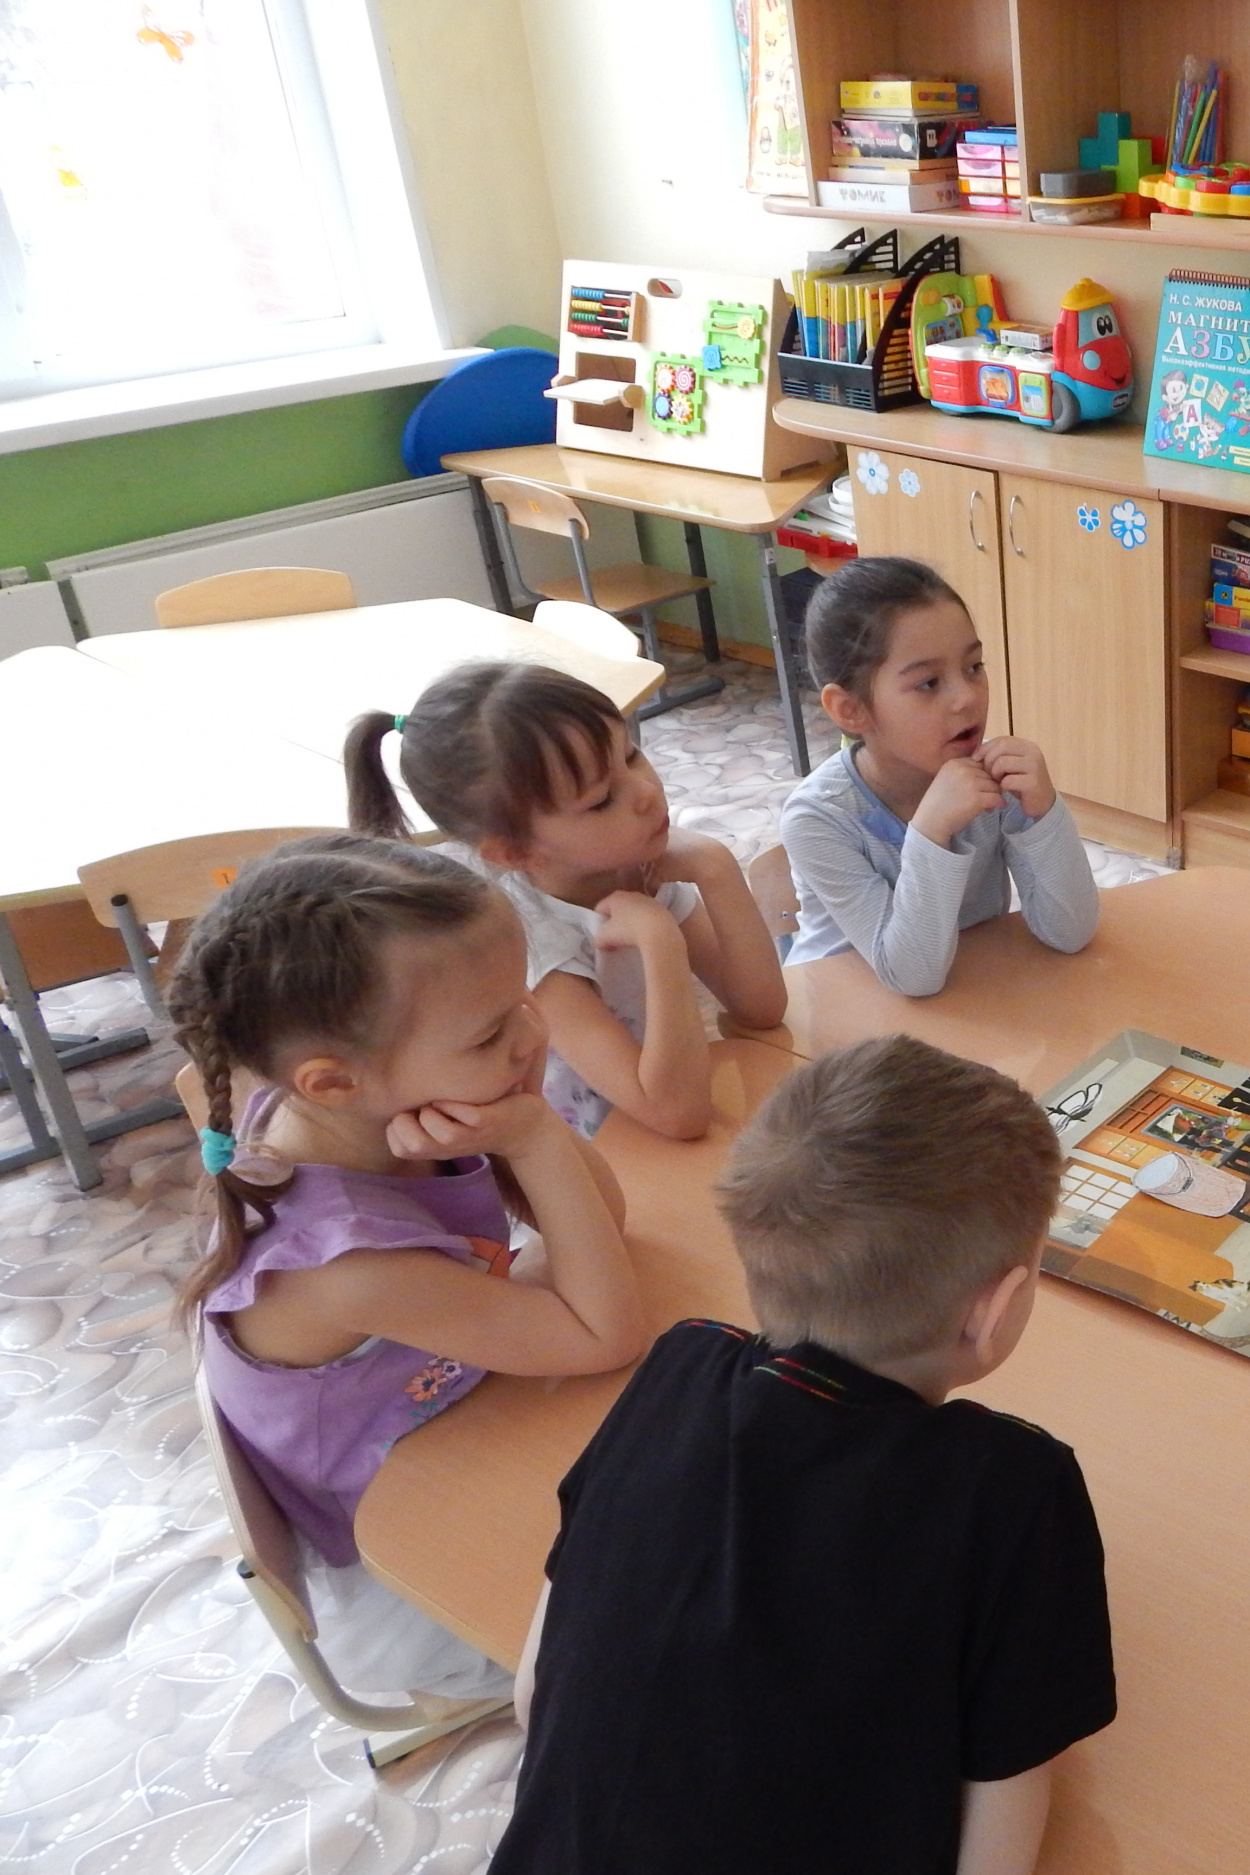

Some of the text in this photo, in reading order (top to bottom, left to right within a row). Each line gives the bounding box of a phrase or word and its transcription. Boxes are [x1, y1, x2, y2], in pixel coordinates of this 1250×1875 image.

[1169, 293, 1242, 312] Н. С. ЖУКОВА
[1161, 355, 1226, 371] Высокоэффективная
